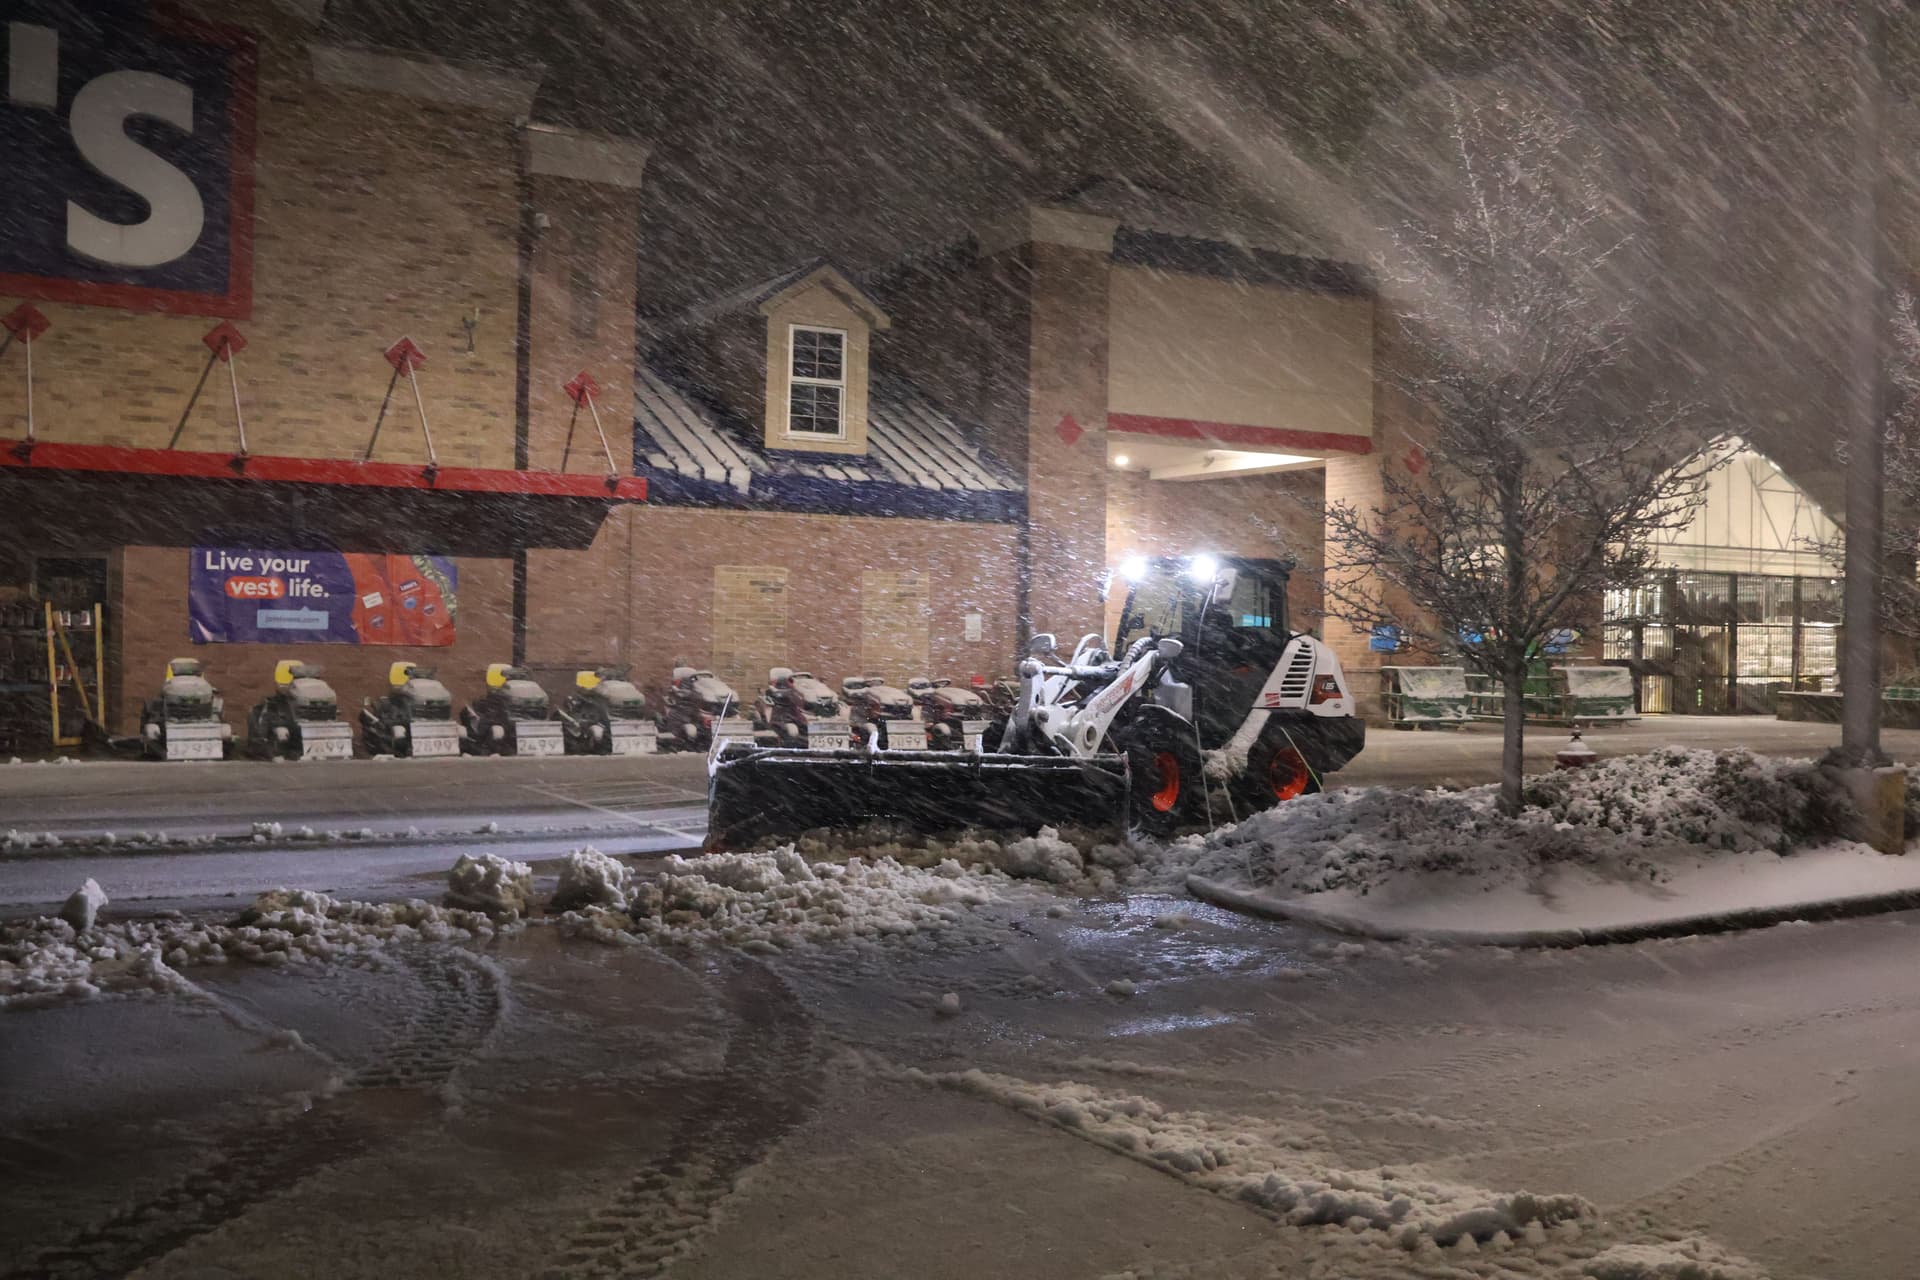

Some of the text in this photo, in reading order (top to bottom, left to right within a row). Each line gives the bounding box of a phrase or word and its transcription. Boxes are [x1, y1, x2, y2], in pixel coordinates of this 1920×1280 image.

[205, 551, 310, 576] Live your
[230, 578, 330, 598] vest life.
